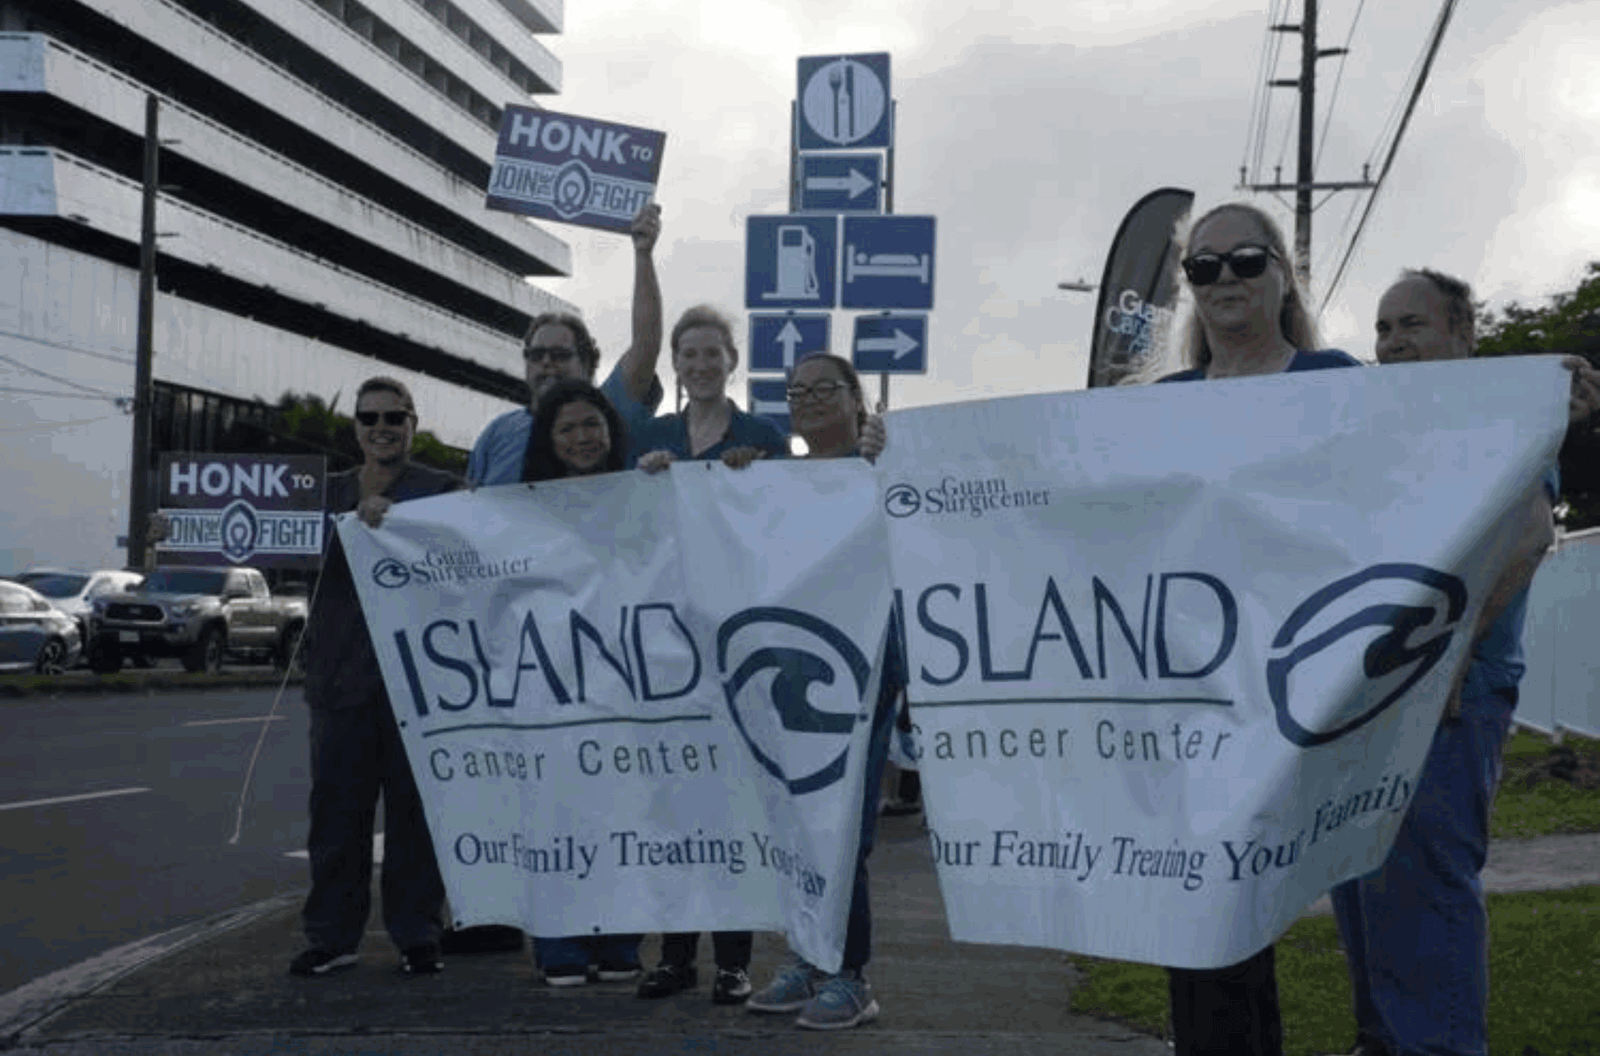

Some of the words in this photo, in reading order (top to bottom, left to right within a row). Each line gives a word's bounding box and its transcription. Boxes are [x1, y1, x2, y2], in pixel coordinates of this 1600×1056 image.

[509, 114, 632, 165] HONK
[630, 144, 654, 162] TO
[493, 163, 540, 195] JOIN
[588, 183, 654, 214] FIGHT
[170, 462, 290, 498] HONK
[292, 474, 315, 490] TO
[941, 475, 1007, 497] Guam
[925, 487, 1051, 518] Surgicenter
[169, 516, 204, 544] OIN
[257, 519, 321, 546] FIGHT
[393, 602, 701, 718] ISLAND
[430, 747, 545, 781] Cancer
[578, 739, 718, 776] Center
[1096, 719, 1232, 761] Center
[454, 832, 508, 866] Our
[609, 828, 747, 875] Treating
[989, 830, 1102, 882] Family
